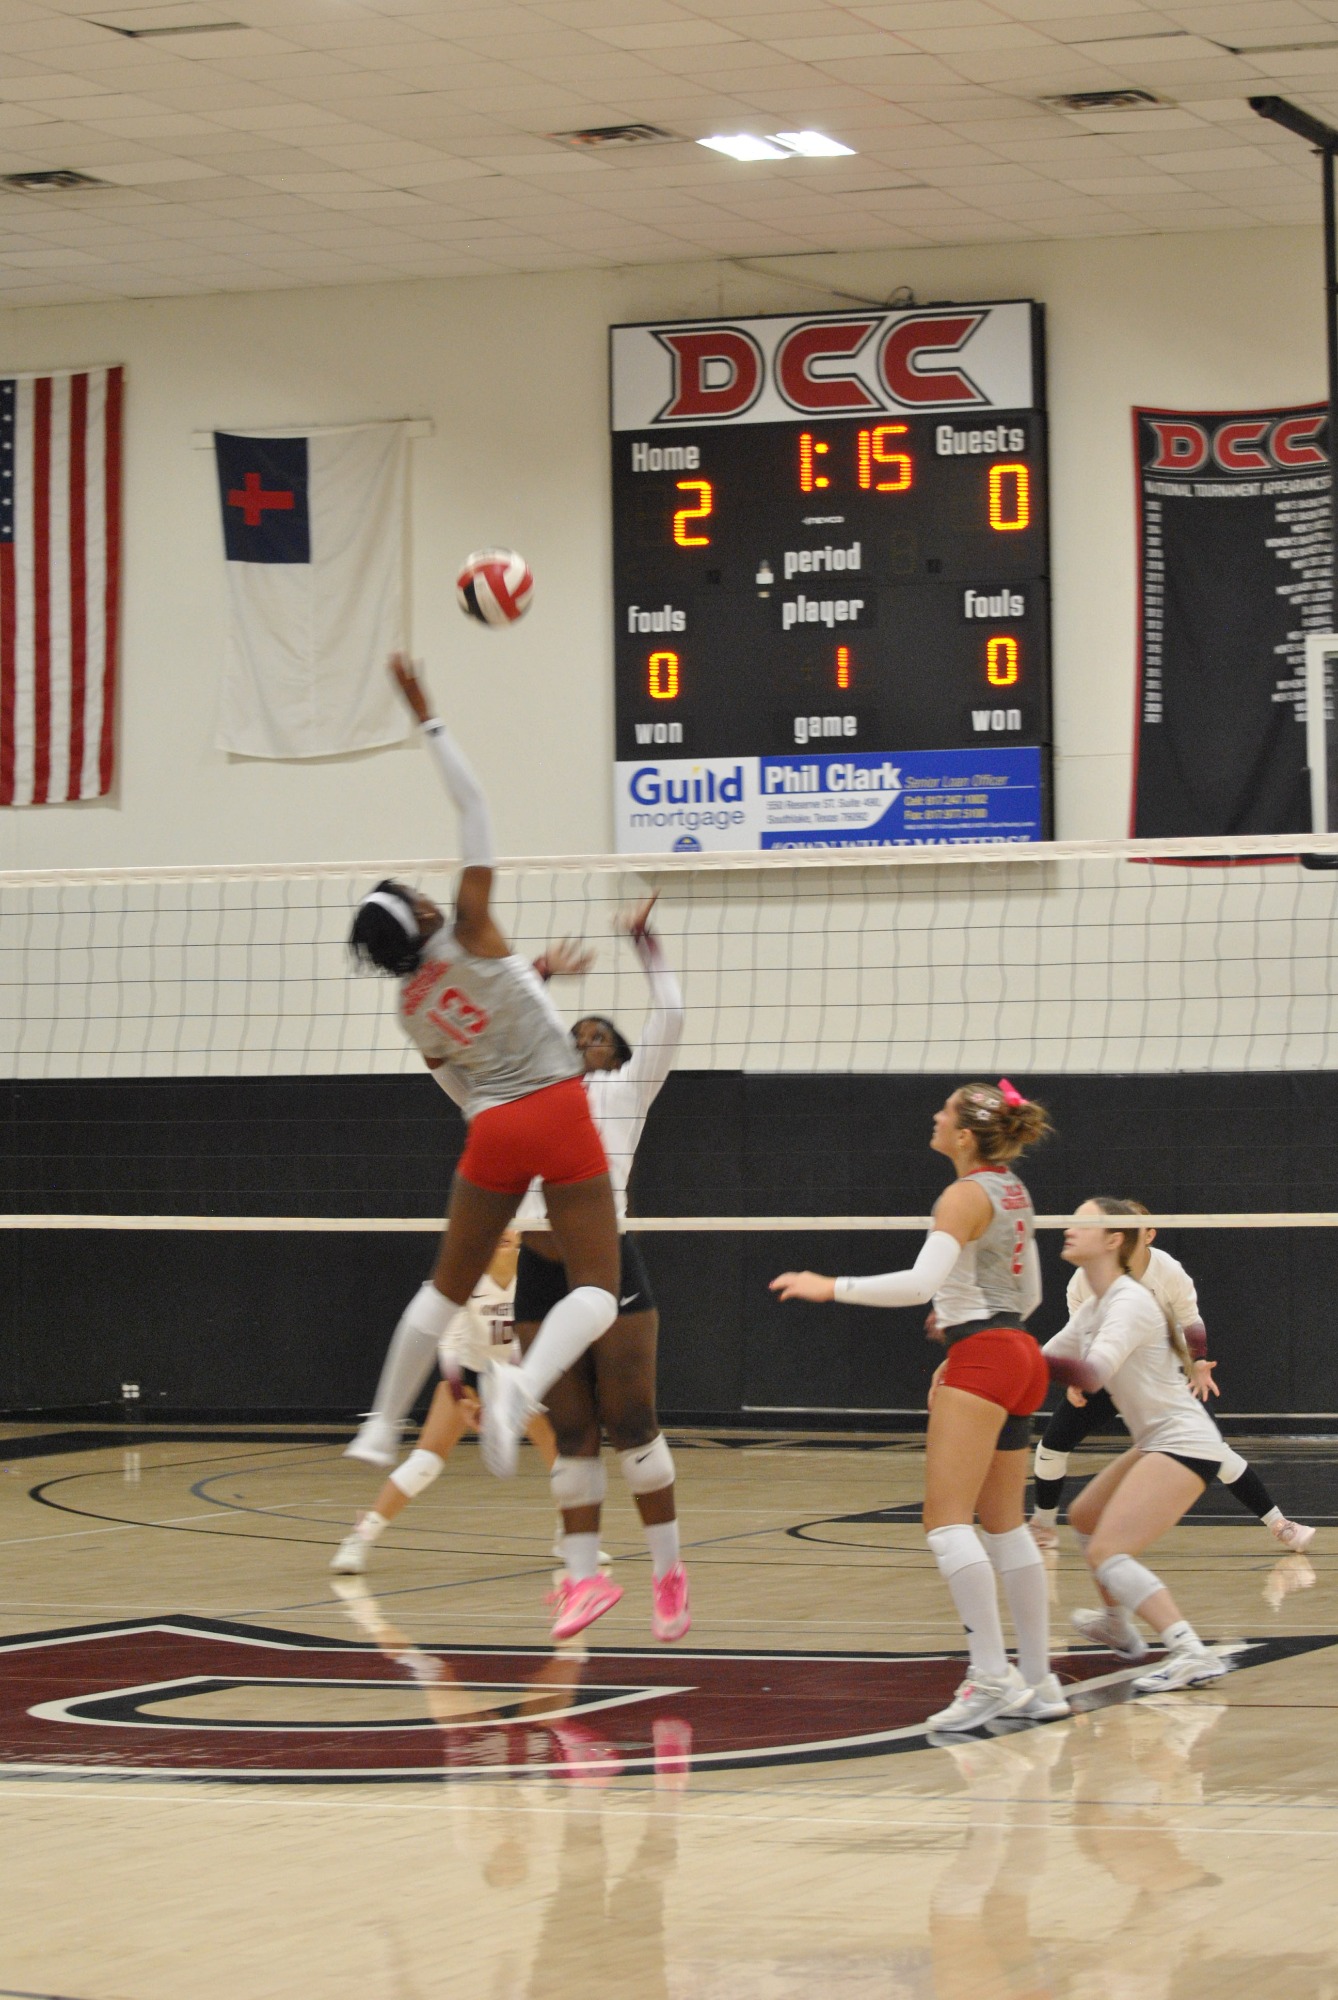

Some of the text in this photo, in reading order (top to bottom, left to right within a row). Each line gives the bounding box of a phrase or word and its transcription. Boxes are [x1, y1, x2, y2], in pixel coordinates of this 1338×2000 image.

[648, 310, 993, 424] DCC
[632, 443, 700, 472] Home
[936, 425, 1025, 455] Guests
[1144, 413, 1329, 474] DCC
[673, 480, 712, 546] 2
[989, 464, 1029, 530] 0
[784, 542, 861, 579] period
[628, 605, 686, 633] fouls
[782, 595, 864, 630] player
[965, 589, 1025, 619] fouls
[648, 651, 679, 699] 0
[836, 646, 849, 688] 1
[986, 637, 1018, 685] 0
[635, 722, 683, 745] won
[794, 715, 857, 744] game
[972, 709, 1022, 731] won
[630, 765, 744, 805] Guild
[765, 762, 901, 793] Phil Clark
[630, 809, 745, 831] mortgage
